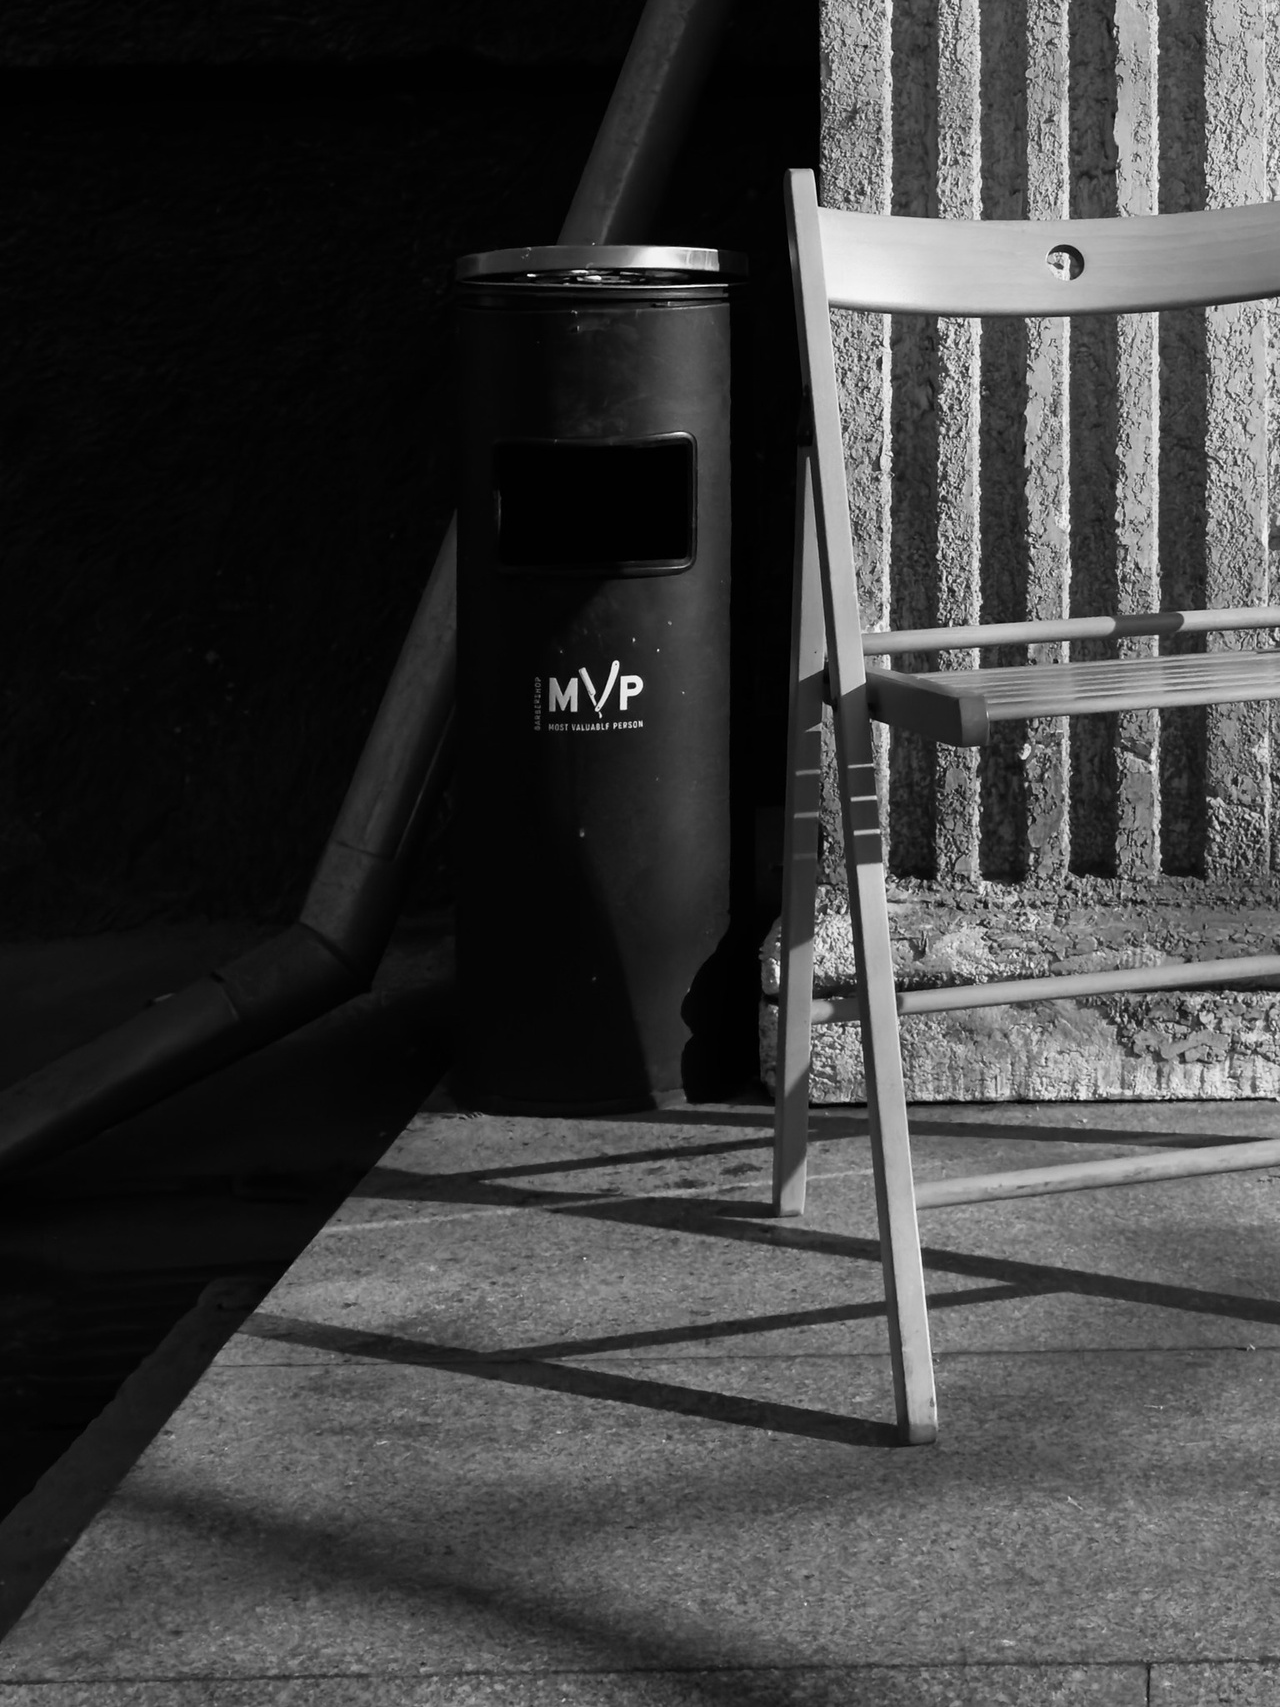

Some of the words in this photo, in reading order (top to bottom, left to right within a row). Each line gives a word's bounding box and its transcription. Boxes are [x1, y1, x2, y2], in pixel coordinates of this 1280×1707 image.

[548, 660, 644, 718] MVP
[548, 723, 569, 732] MOST
[613, 720, 644, 730] PERSON
